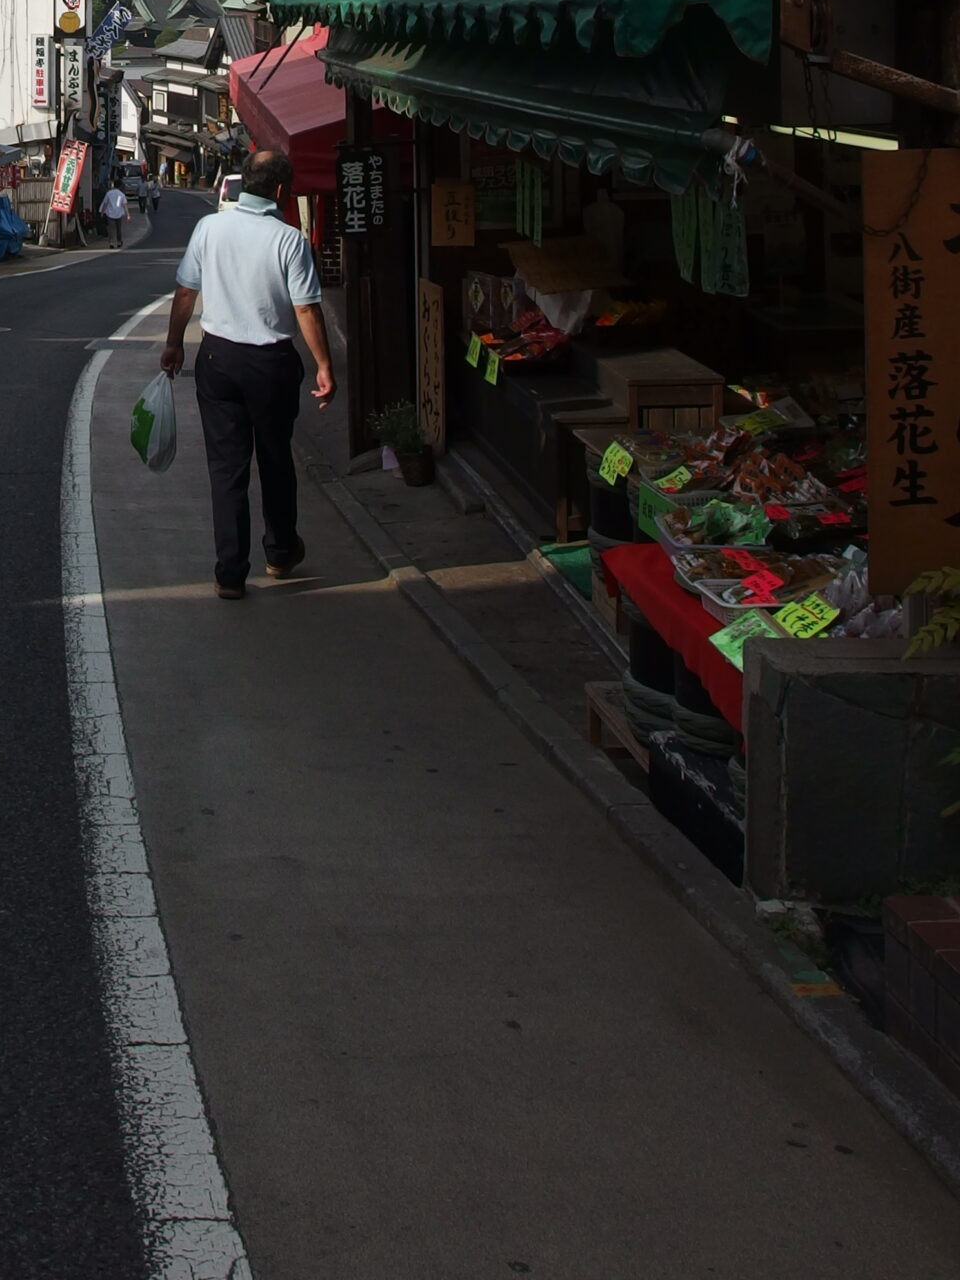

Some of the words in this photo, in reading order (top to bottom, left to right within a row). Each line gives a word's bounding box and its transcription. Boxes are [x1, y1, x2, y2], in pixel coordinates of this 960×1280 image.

[341, 161, 368, 233] 落花生
[367, 154, 385, 225] やちまたの
[888, 231, 939, 508] 八街産落花生
